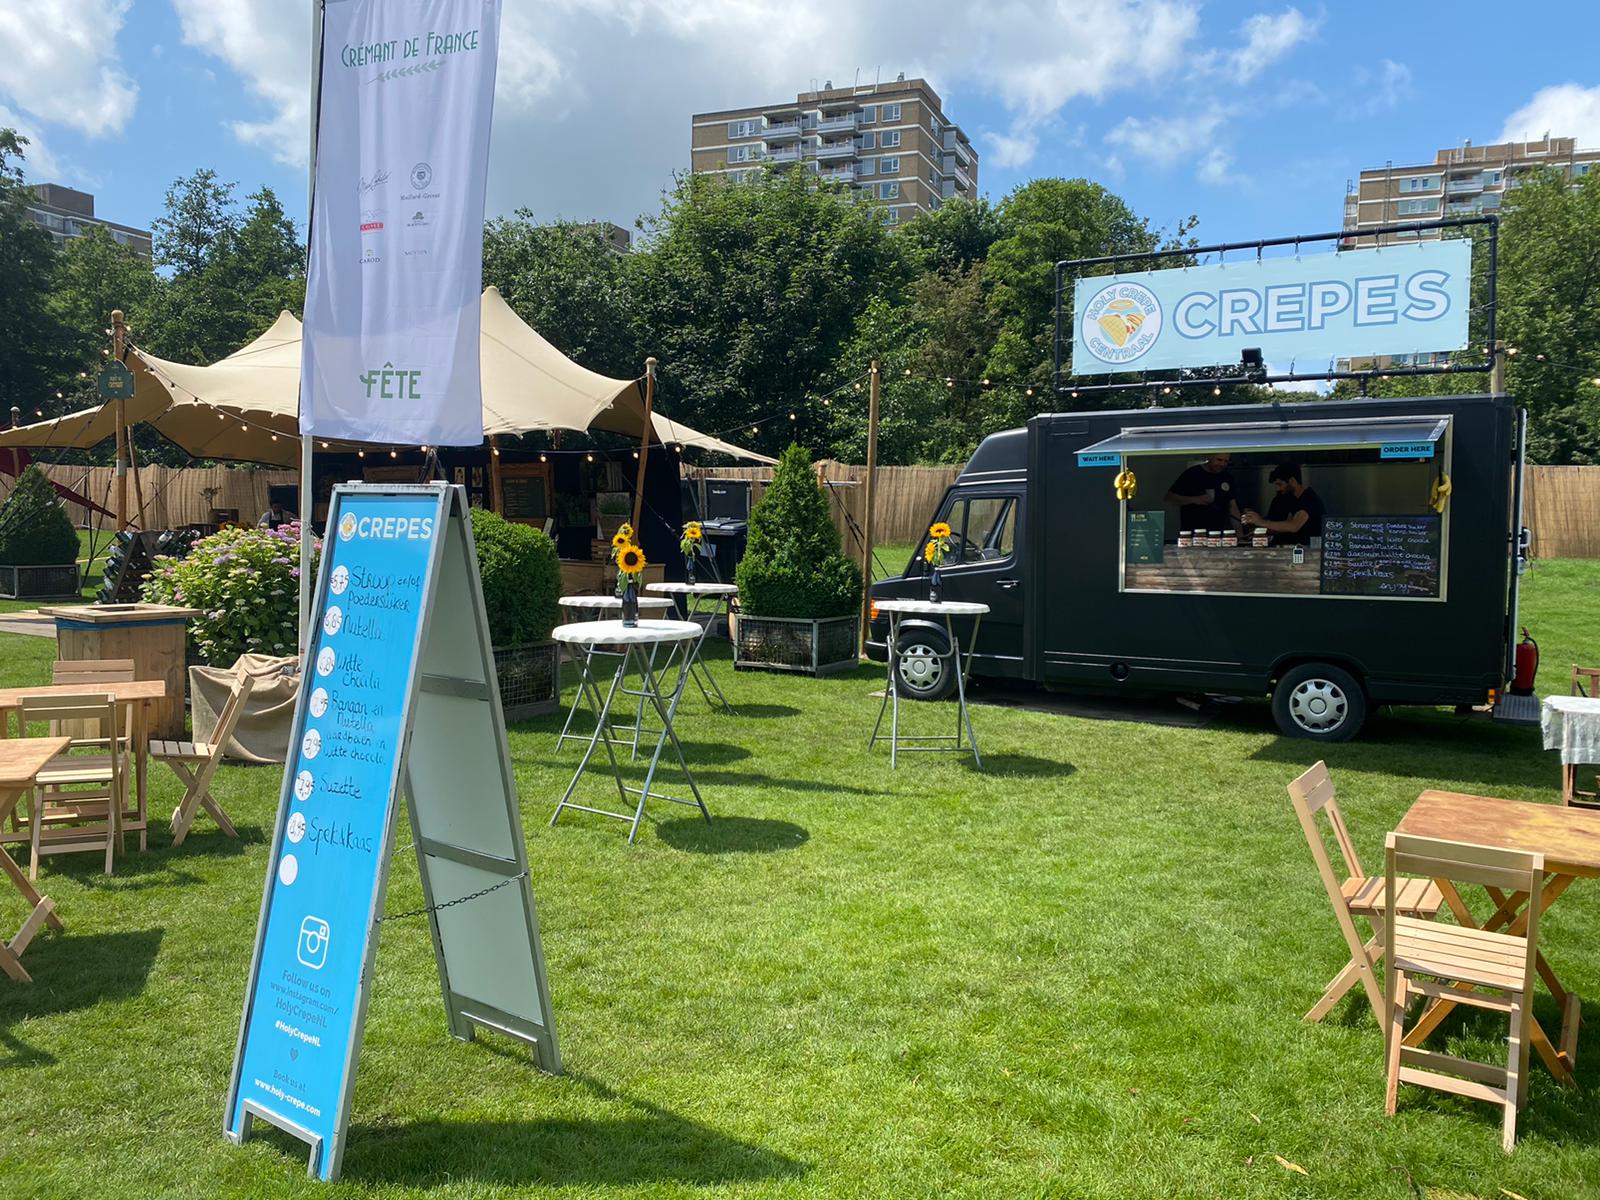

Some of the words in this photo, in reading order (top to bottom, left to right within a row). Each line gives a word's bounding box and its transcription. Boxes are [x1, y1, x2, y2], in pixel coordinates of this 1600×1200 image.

[341, 40, 398, 68] CRÉMANT
[403, 37, 419, 59] DE
[426, 30, 479, 56] FRANCE
[1087, 288, 1117, 320] HOLY
[1120, 287, 1157, 316] CREPE
[1173, 270, 1453, 341] CREPES
[1089, 332, 1154, 361] CENTRAAL
[359, 361, 422, 399] FÊTE
[357, 517, 434, 541] CREPES
[282, 969, 309, 989] Follow
[308, 982, 319, 994] us
[319, 987, 331, 999] on
[276, 997, 328, 1029] HolyCrepeNL
[274, 1019, 321, 1047] #HolyCrepeNL
[273, 1069, 290, 1084] Book
[254, 1078, 321, 1118] www.holy-crepe.com
